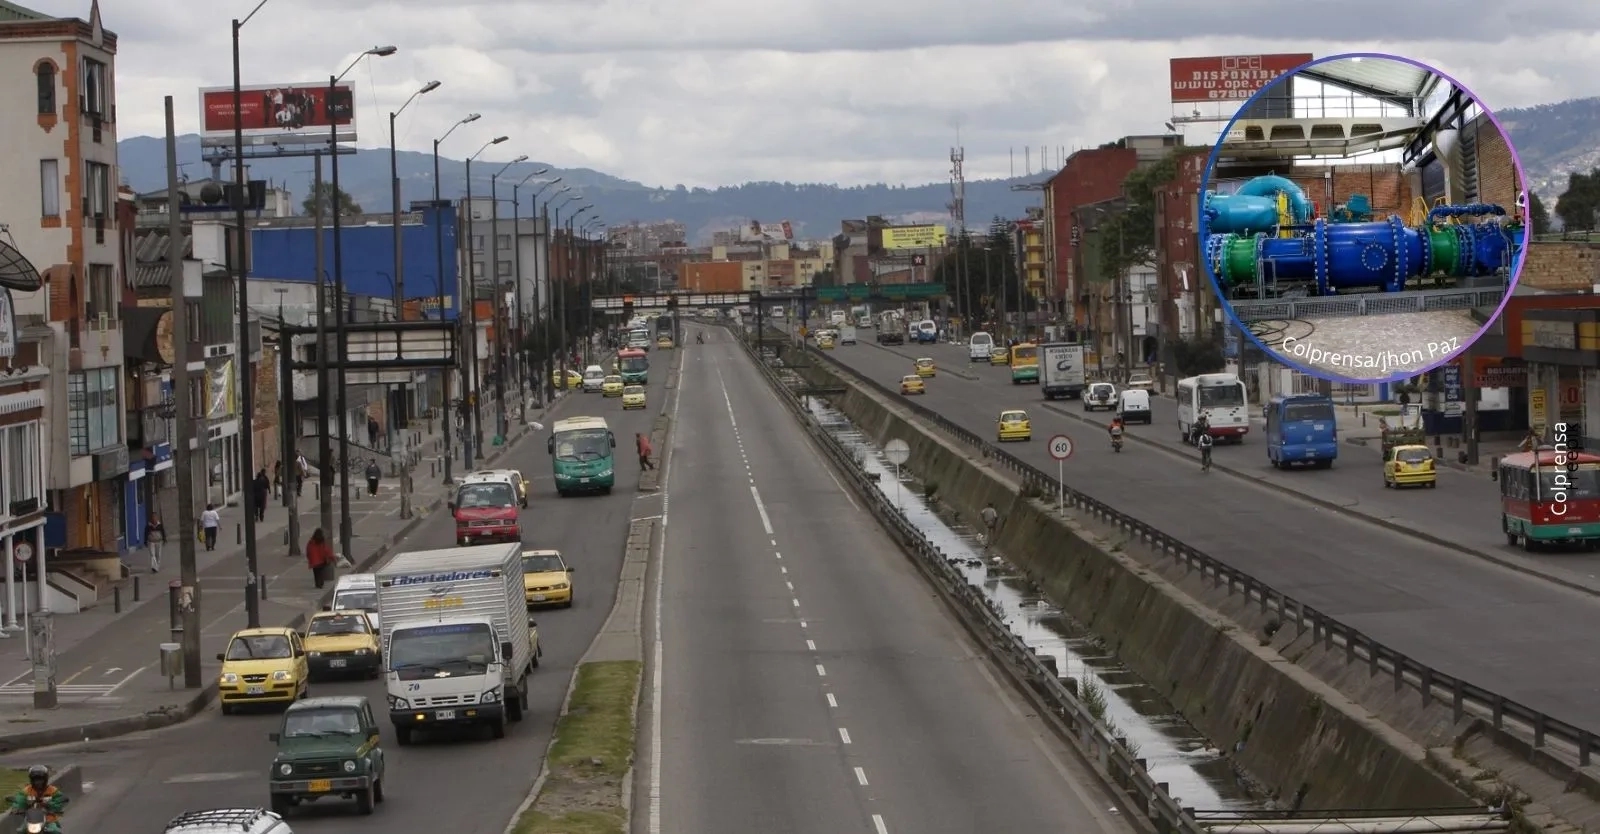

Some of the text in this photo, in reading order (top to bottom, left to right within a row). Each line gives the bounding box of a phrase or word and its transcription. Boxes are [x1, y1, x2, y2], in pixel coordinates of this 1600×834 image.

[1224, 57, 1260, 69] OPE
[1055, 443, 1068, 453] 60
[391, 569, 491, 586] Libertadores
[408, 682, 420, 692] 70
